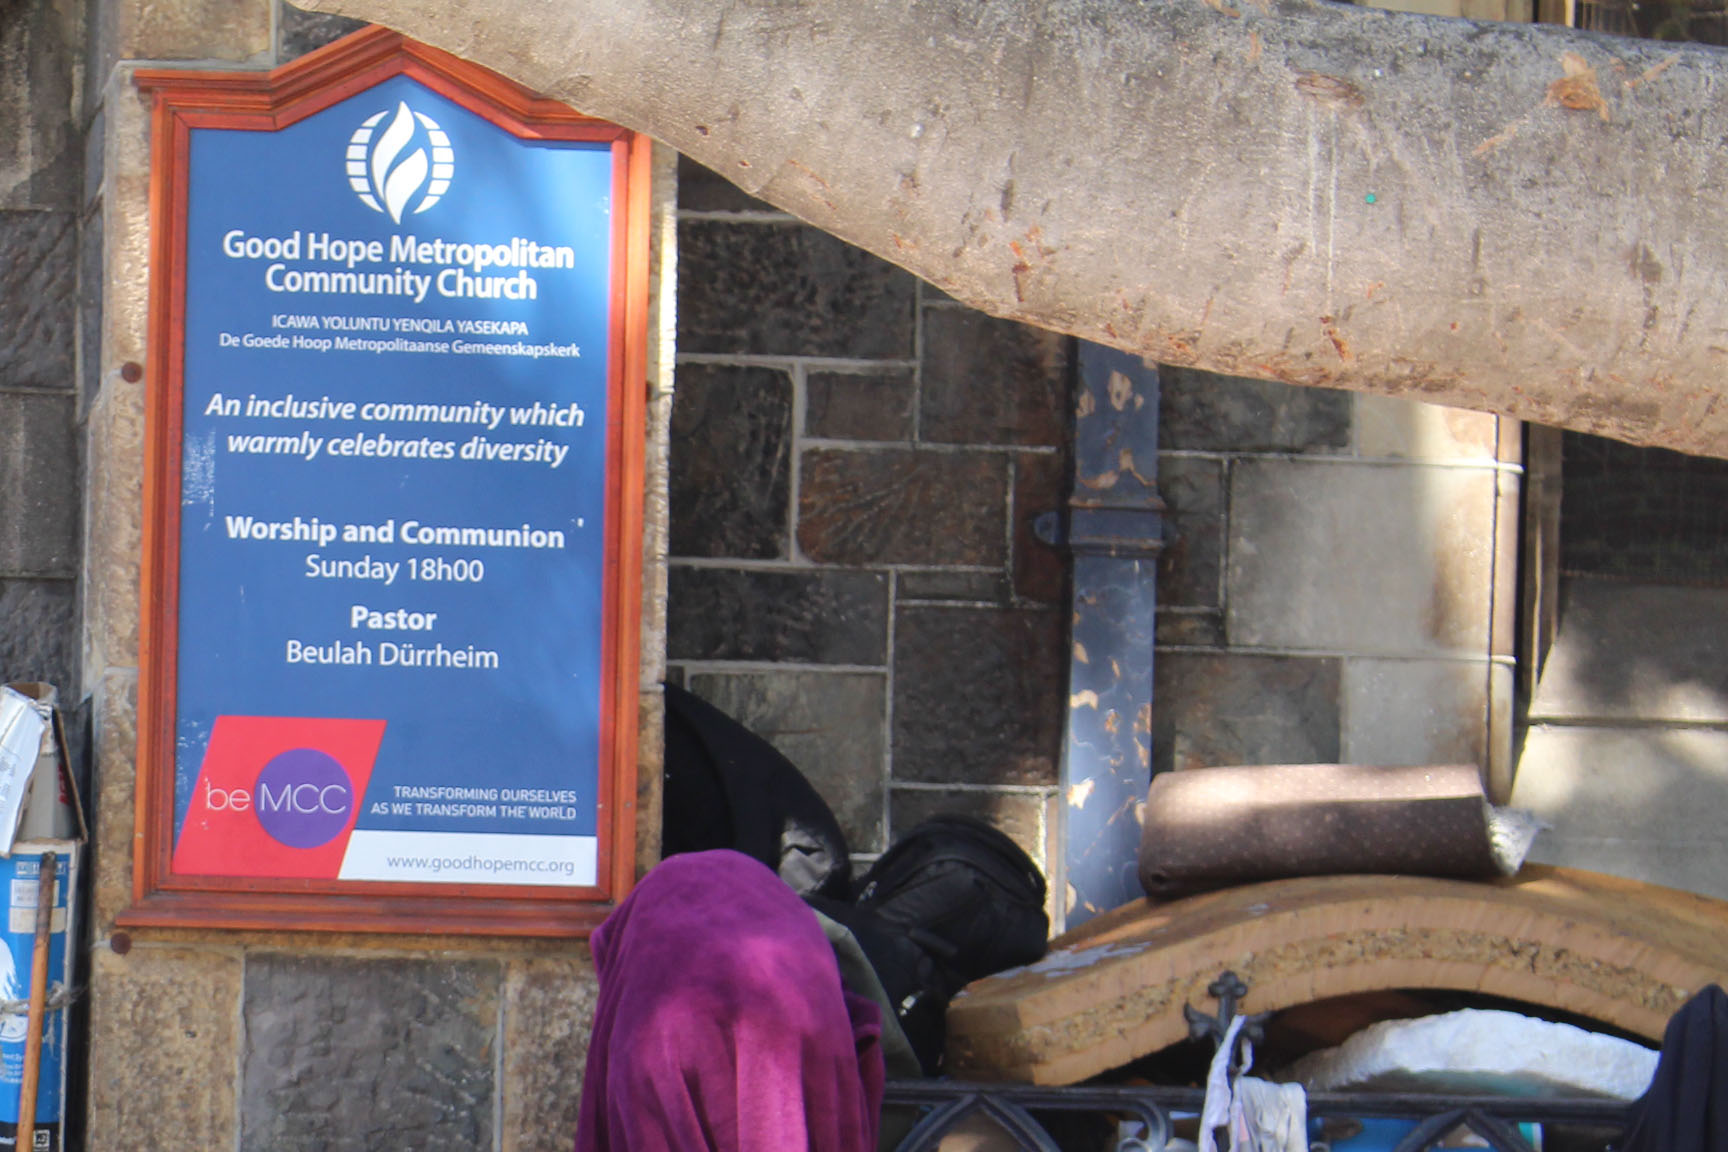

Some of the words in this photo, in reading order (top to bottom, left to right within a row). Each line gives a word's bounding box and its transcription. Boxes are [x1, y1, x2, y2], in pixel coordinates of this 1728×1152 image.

[223, 230, 301, 260] Good
[307, 232, 384, 269] Hope
[390, 235, 575, 272] Metropolitan
[265, 262, 432, 303] Community
[437, 266, 538, 300] Church
[272, 314, 320, 329] ICAWA
[321, 316, 391, 332] YOLUNTU
[391, 318, 455, 334] YENQILA
[457, 320, 529, 336] YASEKAPA
[219, 332, 239, 347] De
[242, 333, 290, 349] Goede
[292, 335, 333, 353] Hoop
[334, 336, 450, 354] Metropolitaanse
[451, 339, 581, 359] Gemeenskapskerk
[204, 393, 241, 416] An
[245, 394, 356, 420] inclusive
[360, 400, 506, 430] community
[510, 401, 585, 427] which
[227, 430, 324, 461] warmly
[326, 432, 456, 459] celebrates
[459, 436, 569, 468] diversity
[225, 515, 337, 547] Worship
[342, 519, 395, 543] and
[400, 521, 565, 549] Communion
[305, 554, 400, 585] Sunday
[407, 557, 484, 582] 18h00
[351, 605, 437, 631] Pastor
[286, 639, 372, 665] Beulah
[379, 642, 499, 669] Dürrheim
[204, 781, 251, 812] be
[260, 783, 347, 814] MCC
[393, 785, 499, 801] TRANSFORMING
[500, 788, 577, 804] OURSELVES
[370, 802, 389, 815] AS
[391, 802, 412, 816] WE
[415, 803, 497, 818] TRANSFORM
[499, 805, 528, 818] THE
[528, 806, 577, 820] WORLD
[386, 855, 575, 876] www.goodhopemcc.org
